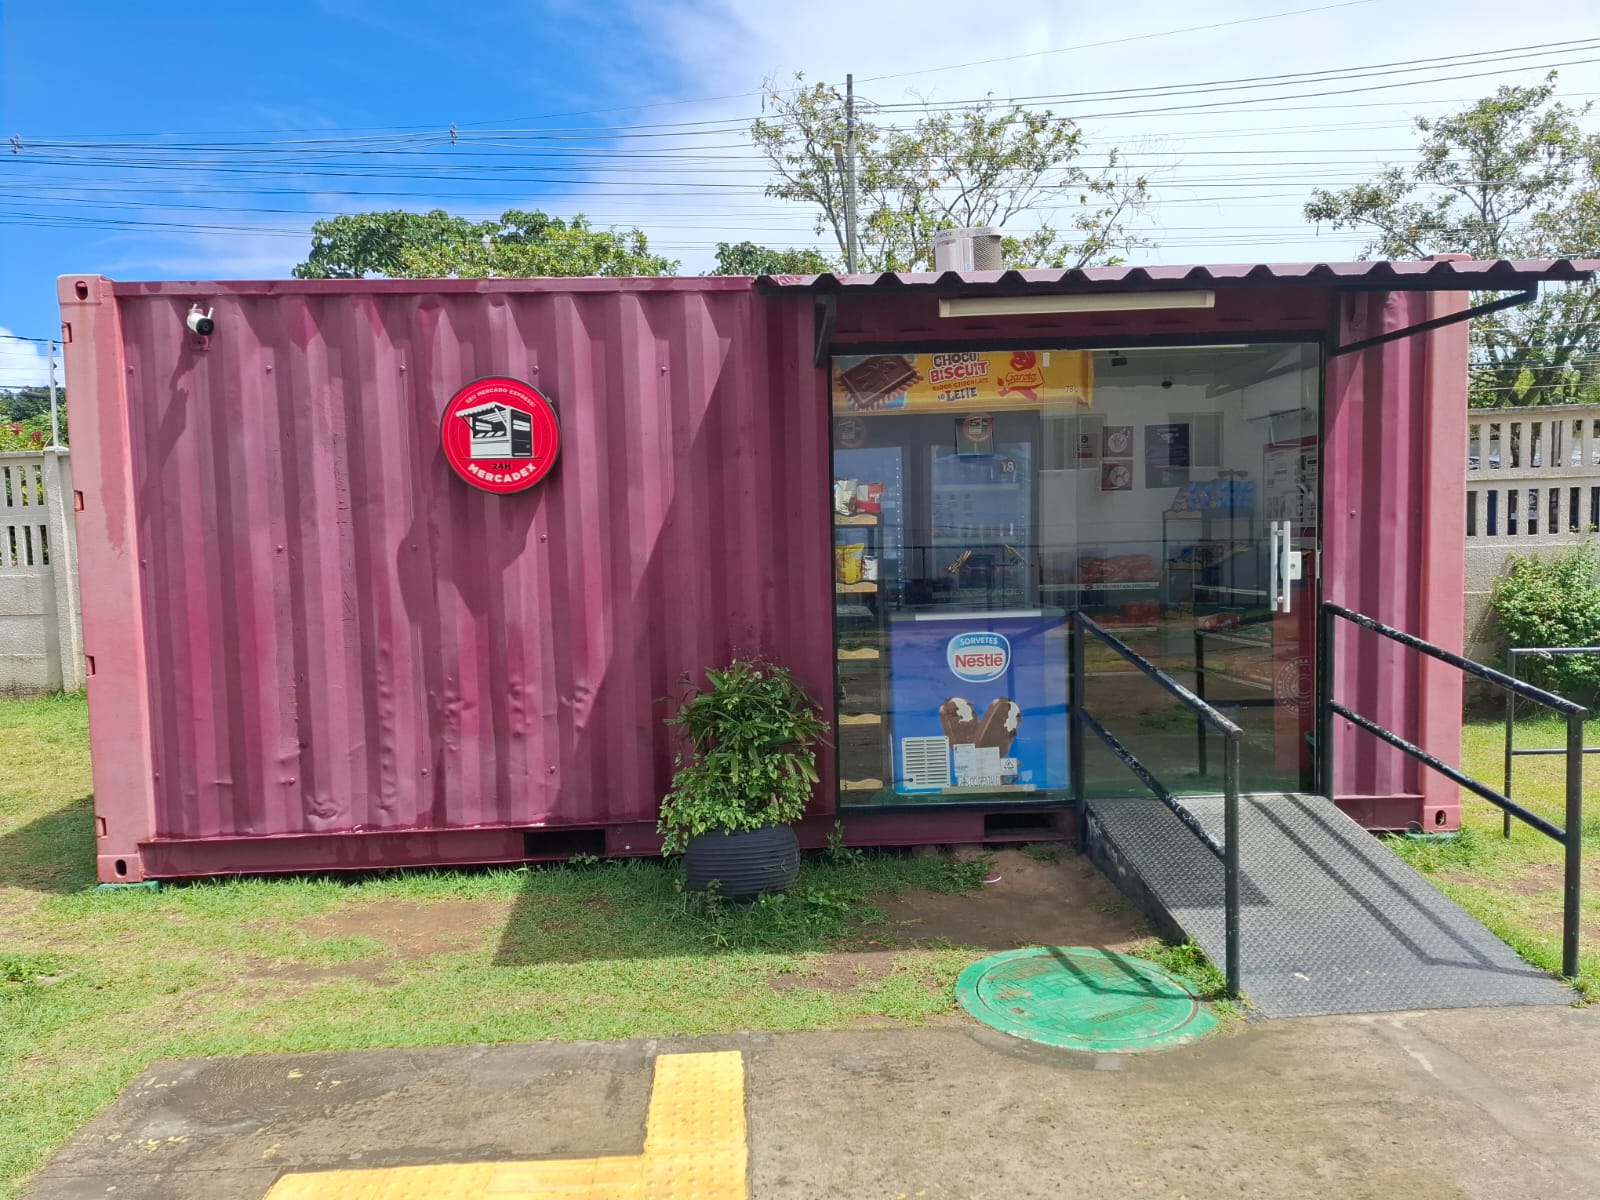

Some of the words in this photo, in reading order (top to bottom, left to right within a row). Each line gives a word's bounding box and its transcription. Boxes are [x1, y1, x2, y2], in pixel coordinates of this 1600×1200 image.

[933, 352, 978, 367] CHOCO
[930, 362, 988, 383] BISCUIT
[477, 387, 508, 397] MERCADO
[946, 387, 978, 402] LEITE
[467, 463, 537, 483] MERCADEX
[959, 636, 999, 646] SORVETES
[955, 653, 1003, 668] Nestlé
